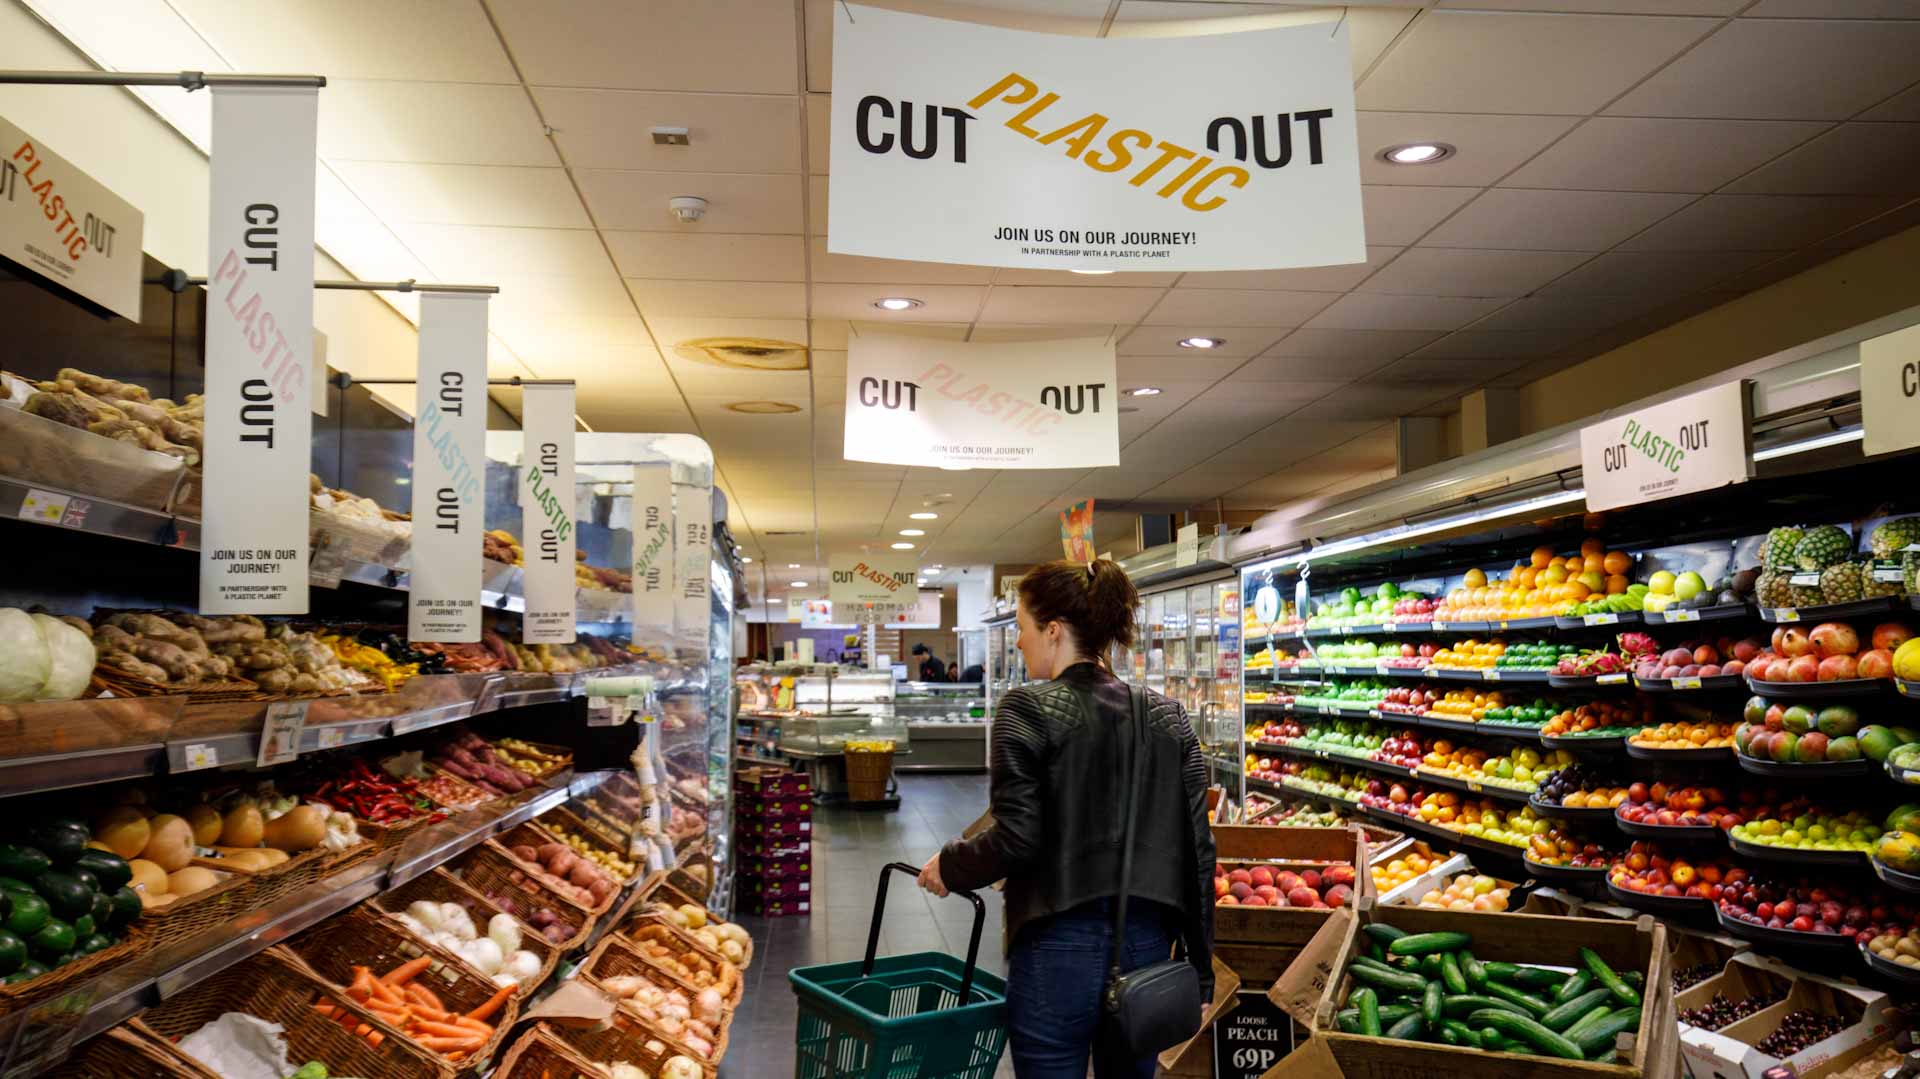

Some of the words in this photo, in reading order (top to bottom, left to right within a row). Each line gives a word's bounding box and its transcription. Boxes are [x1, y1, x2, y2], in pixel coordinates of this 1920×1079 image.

[855, 95, 979, 163] CUT
[966, 72, 1251, 212] PLASTIC
[1206, 108, 1333, 169] OUT
[13, 141, 89, 261] PLASTIC
[84, 212, 117, 258] OUT
[243, 203, 279, 272] CUT
[994, 227, 1029, 241] JOIN
[1034, 228, 1054, 243] US
[1059, 230, 1079, 244] ON
[1085, 231, 1116, 245] OUR
[1121, 231, 1197, 245] JOURNEY!
[1031, 247, 1081, 256] PARTNERSHIP
[1083, 249, 1101, 257] WITH
[1110, 250, 1140, 258] PLASTIC
[1142, 250, 1170, 258] PLANET
[214, 247, 305, 404] PLASTIC
[439, 371, 464, 417] CUT
[859, 376, 921, 412] CUT
[1902, 360, 1920, 397] C
[239, 379, 275, 449] OUT
[917, 362, 1064, 440] PLASTIC
[1040, 383, 1106, 415] OUT
[418, 400, 482, 505] PLASTIC
[949, 445, 960, 454] US
[962, 446, 974, 454] ON
[976, 447, 993, 455] OUR
[994, 447, 1034, 456] JOURNEY!
[1621, 419, 1685, 473] PLASTIC
[1679, 420, 1709, 450] OUT
[540, 442, 558, 476] CUT
[1604, 443, 1627, 472] CUT
[435, 487, 459, 534] OUT
[525, 465, 573, 542] PLASTIC
[211, 550, 235, 560] JOIN
[239, 549, 253, 560] US
[256, 549, 271, 560] ON
[275, 549, 296, 560] OUR
[540, 529, 558, 563] OUT
[227, 563, 280, 574] JOURNEY!
[832, 570, 854, 583] CUT
[852, 562, 902, 592] PLASTIC
[893, 572, 915, 584] OUT
[1227, 1027, 1278, 1041] PEACH
[1236, 1016, 1268, 1025] LOOSE
[1232, 1048, 1276, 1069] 69P
